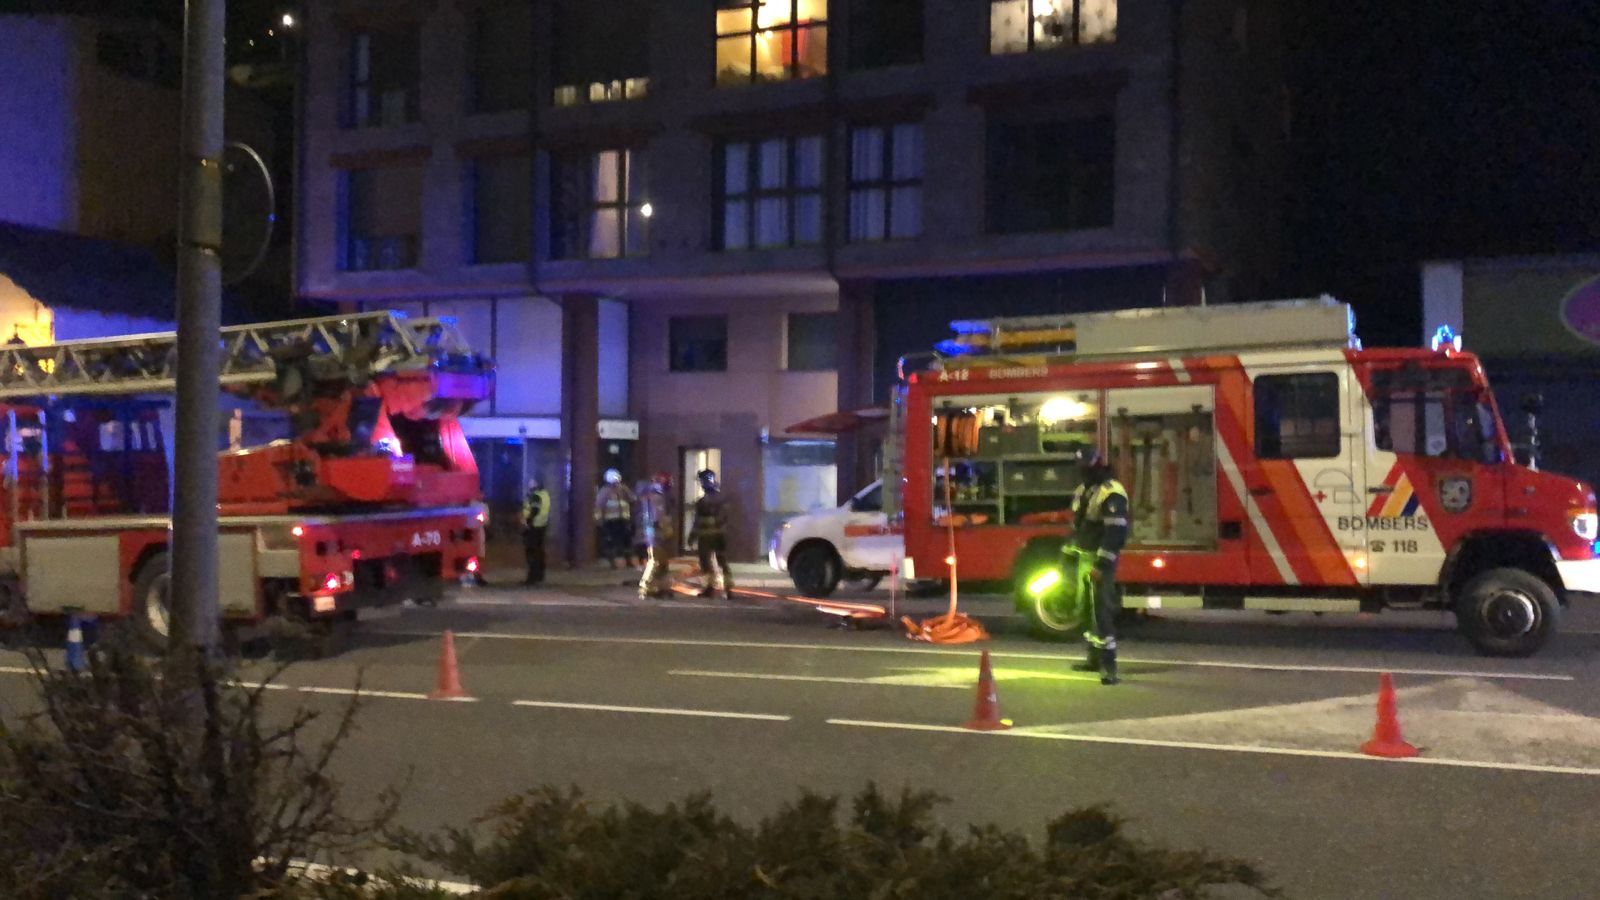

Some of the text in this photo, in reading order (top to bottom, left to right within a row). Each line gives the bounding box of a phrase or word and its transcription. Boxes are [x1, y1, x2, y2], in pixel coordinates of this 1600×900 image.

[989, 366, 1048, 379] BOMBERS
[1337, 515, 1428, 531] BOMBERS
[1393, 540, 1418, 553] 118
